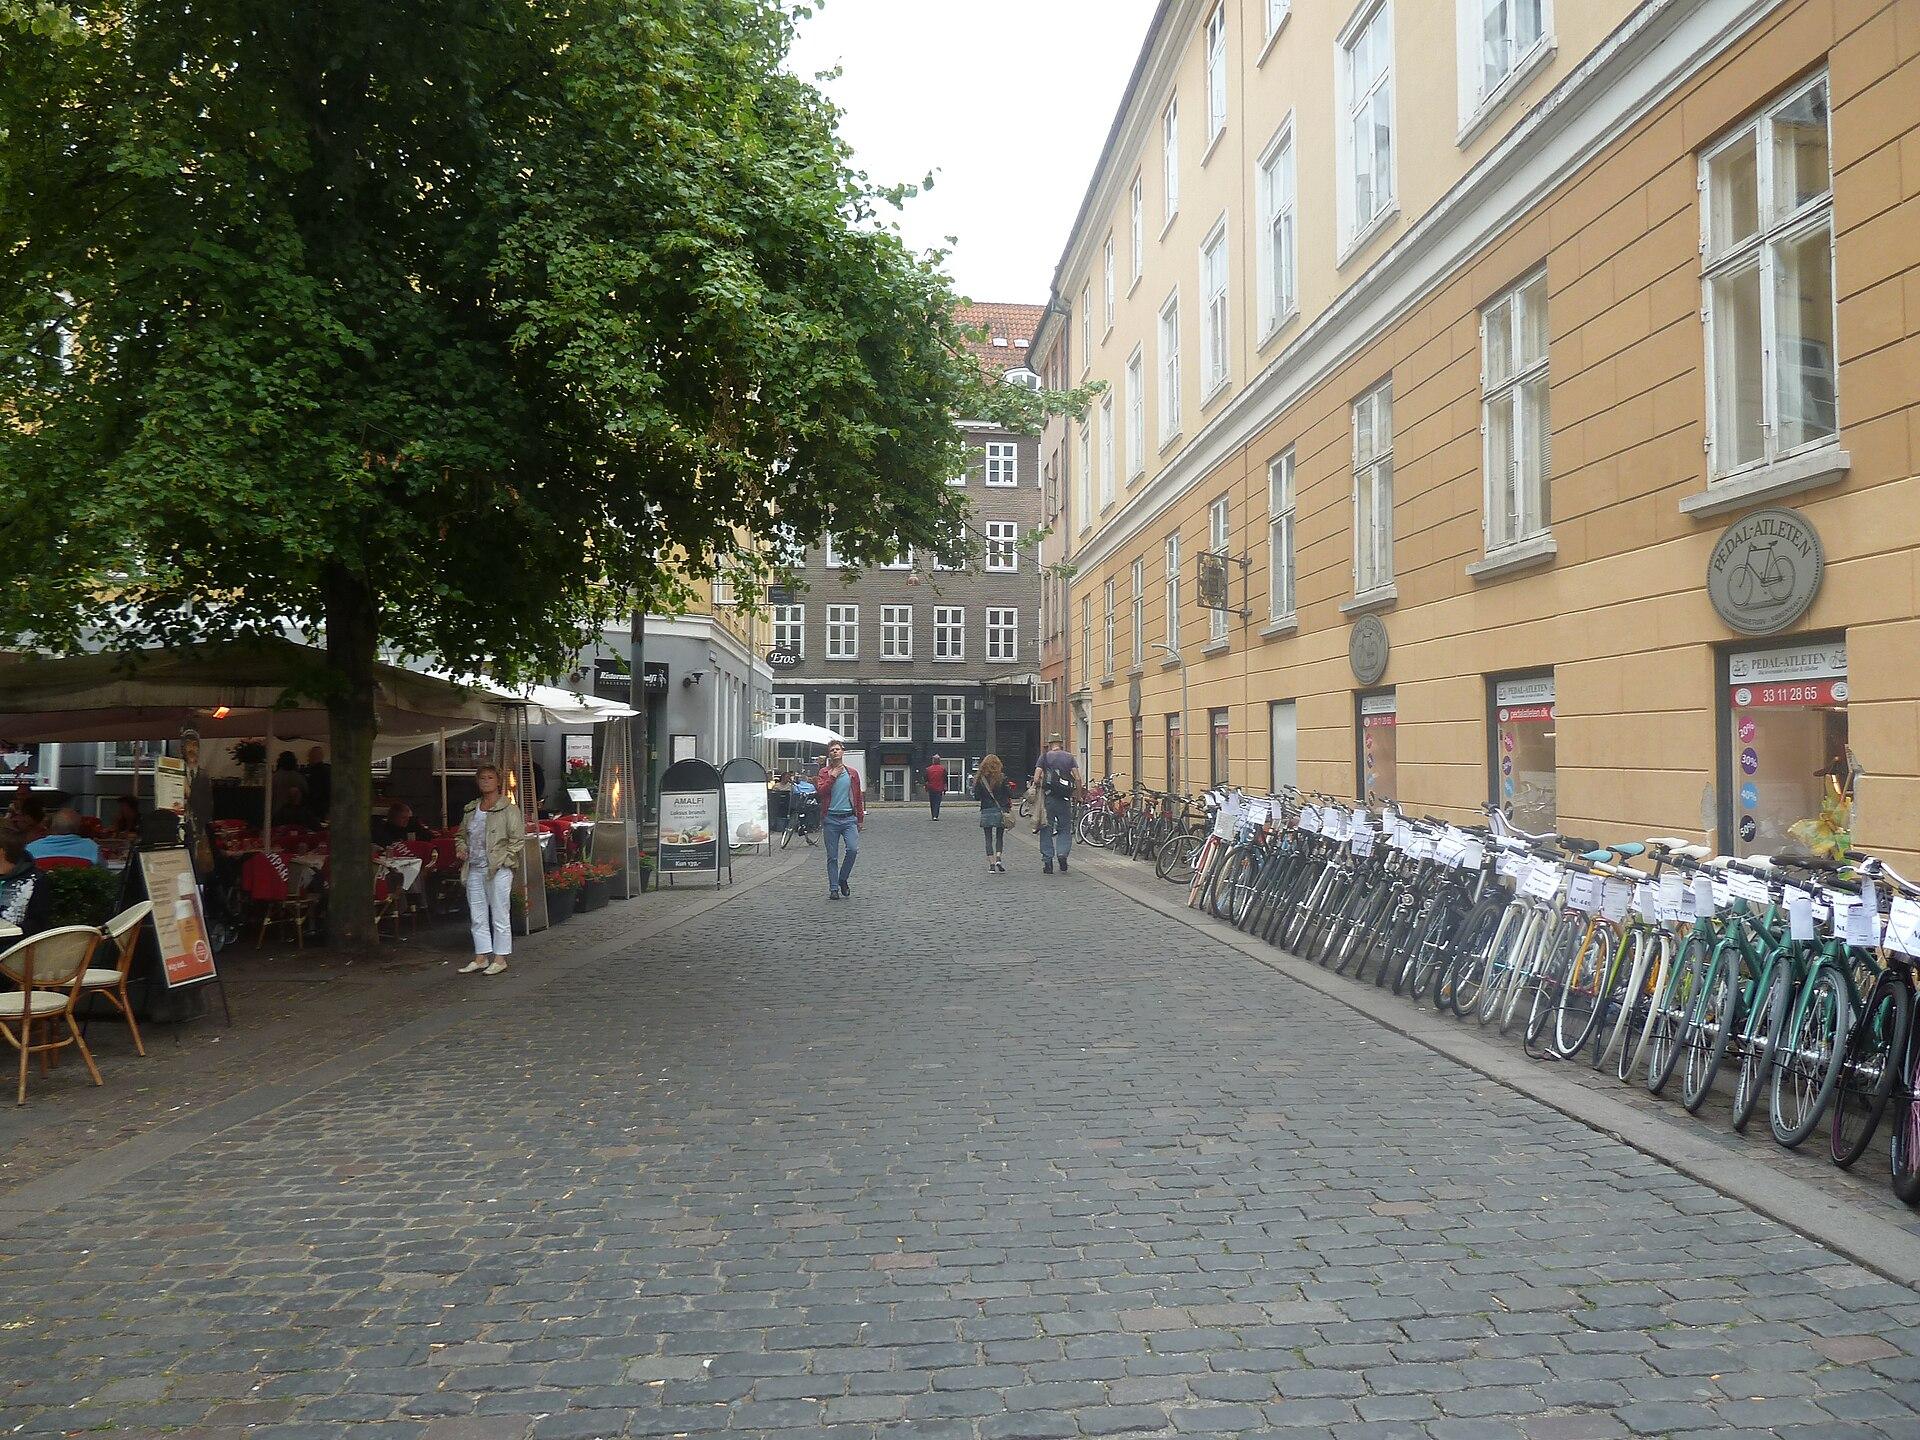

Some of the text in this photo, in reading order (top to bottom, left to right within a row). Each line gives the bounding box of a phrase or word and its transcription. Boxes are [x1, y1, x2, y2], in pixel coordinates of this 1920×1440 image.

[1714, 519, 1812, 574] PEDAL-ATLETEN
[771, 652, 796, 664] Eros
[1751, 652, 1826, 670] PEDAL-ATLETEN
[1763, 686, 1817, 702] 33 11 28 65
[1739, 721, 1755, 738] 20%
[1741, 754, 1758, 768] 30%
[1741, 789, 1757, 802] 40%
[1740, 820, 1756, 837] 50%
